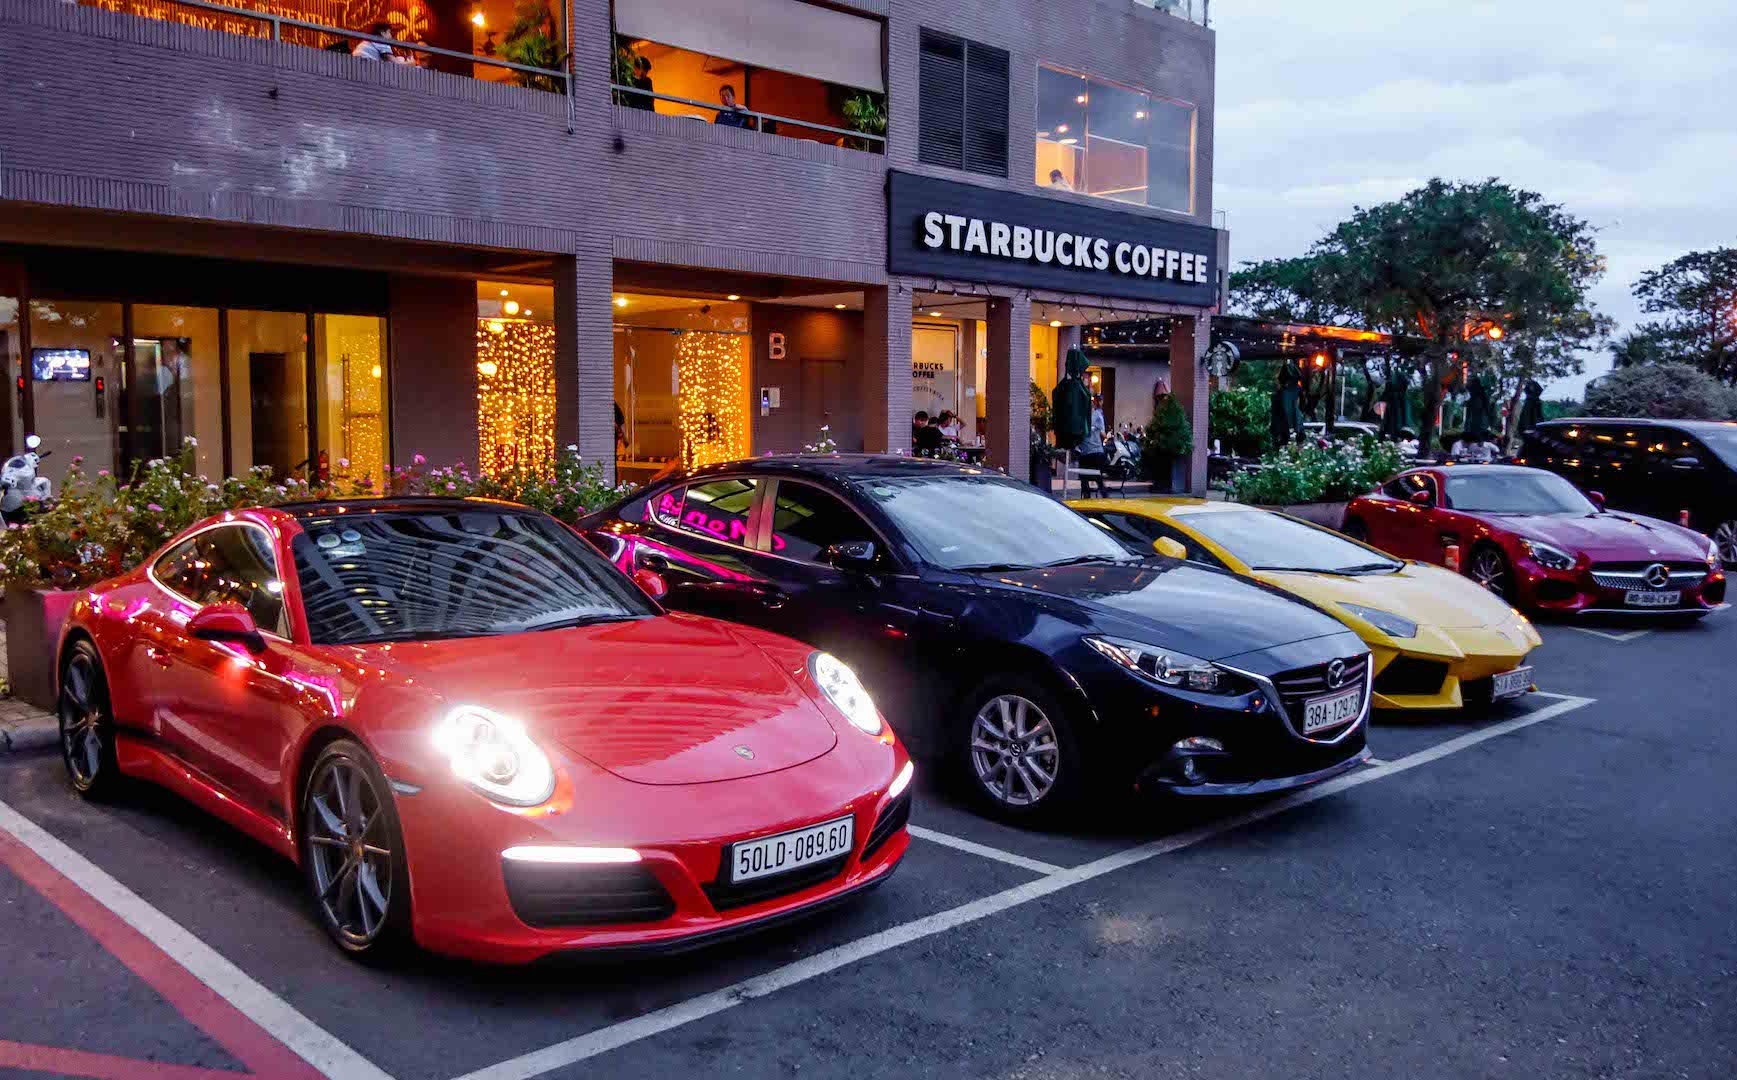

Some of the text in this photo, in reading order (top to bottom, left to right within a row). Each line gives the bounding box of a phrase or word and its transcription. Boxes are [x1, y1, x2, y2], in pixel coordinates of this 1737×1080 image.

[177, 11, 218, 30] TINY
[923, 211, 1208, 284] STARBUCKS COFFEE
[768, 332, 786, 360] B
[740, 824, 847, 875] 50LD-089.60
